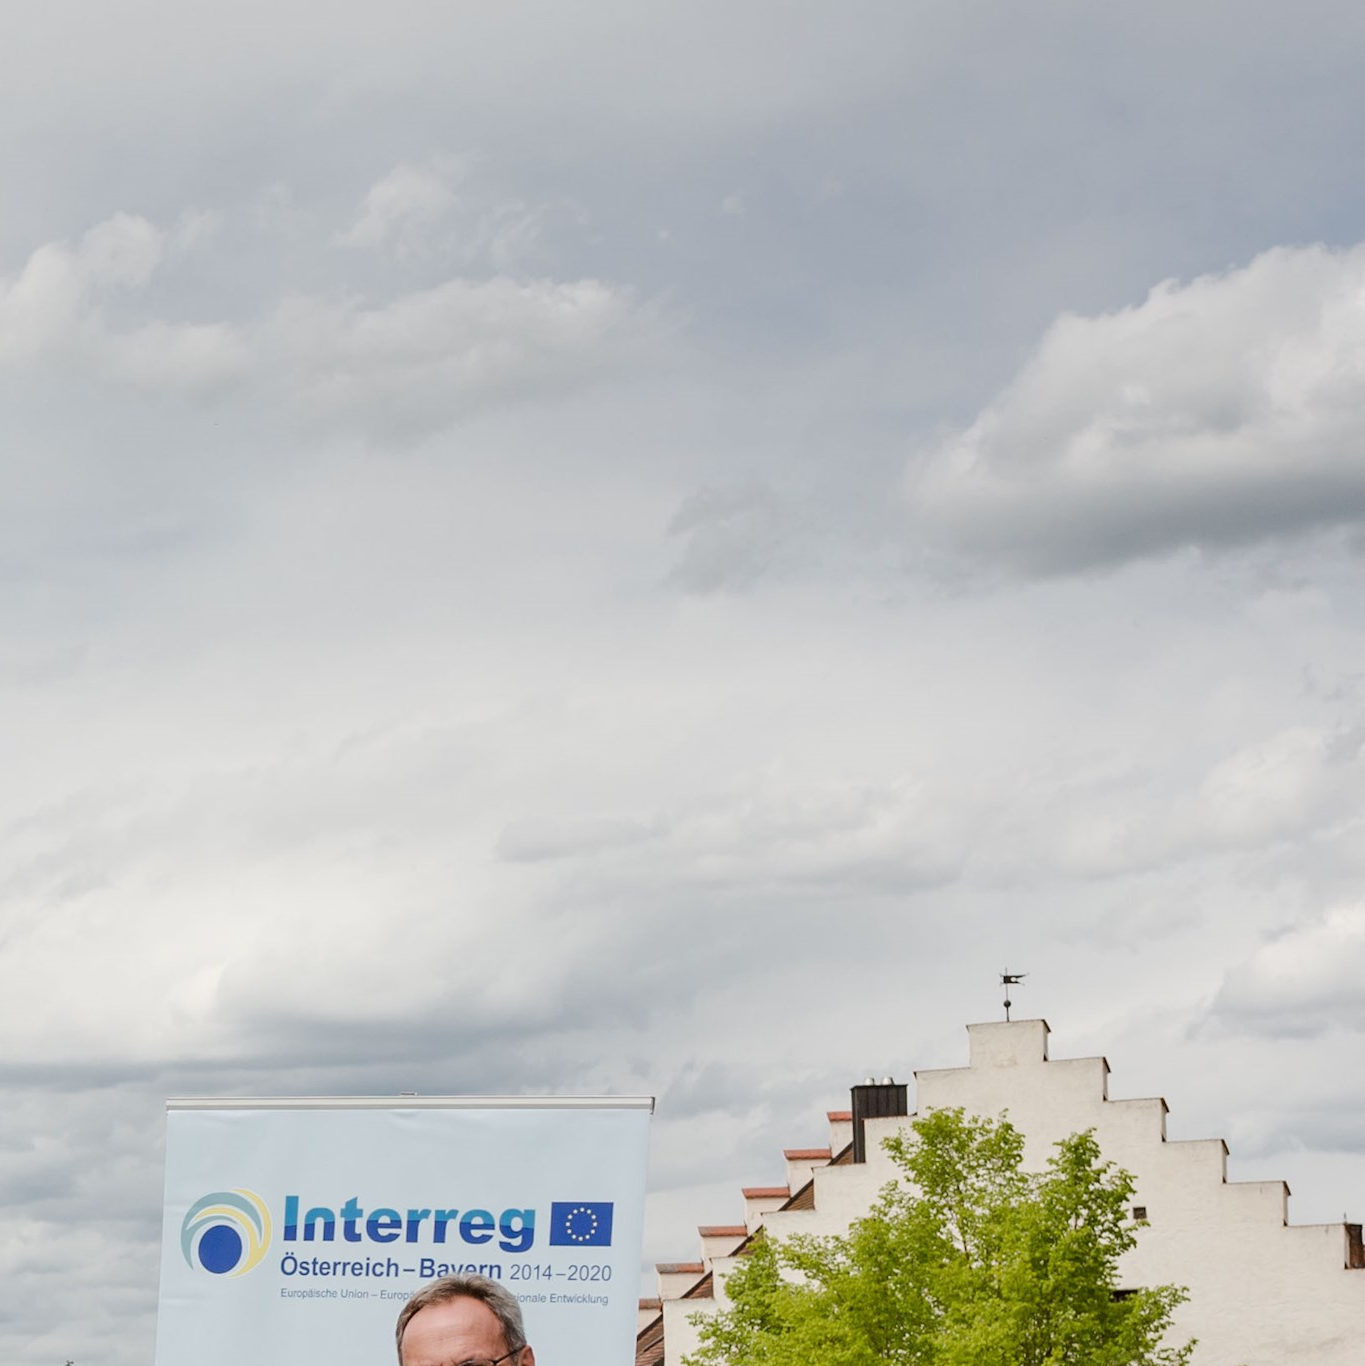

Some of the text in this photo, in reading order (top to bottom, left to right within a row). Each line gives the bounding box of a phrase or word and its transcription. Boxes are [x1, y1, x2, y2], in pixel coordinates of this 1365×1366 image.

[283, 1195, 536, 1253] Interreg
[280, 1288, 338, 1300] Europäische
[341, 1288, 369, 1299] Union
[549, 1293, 609, 1306] Entwicklung
